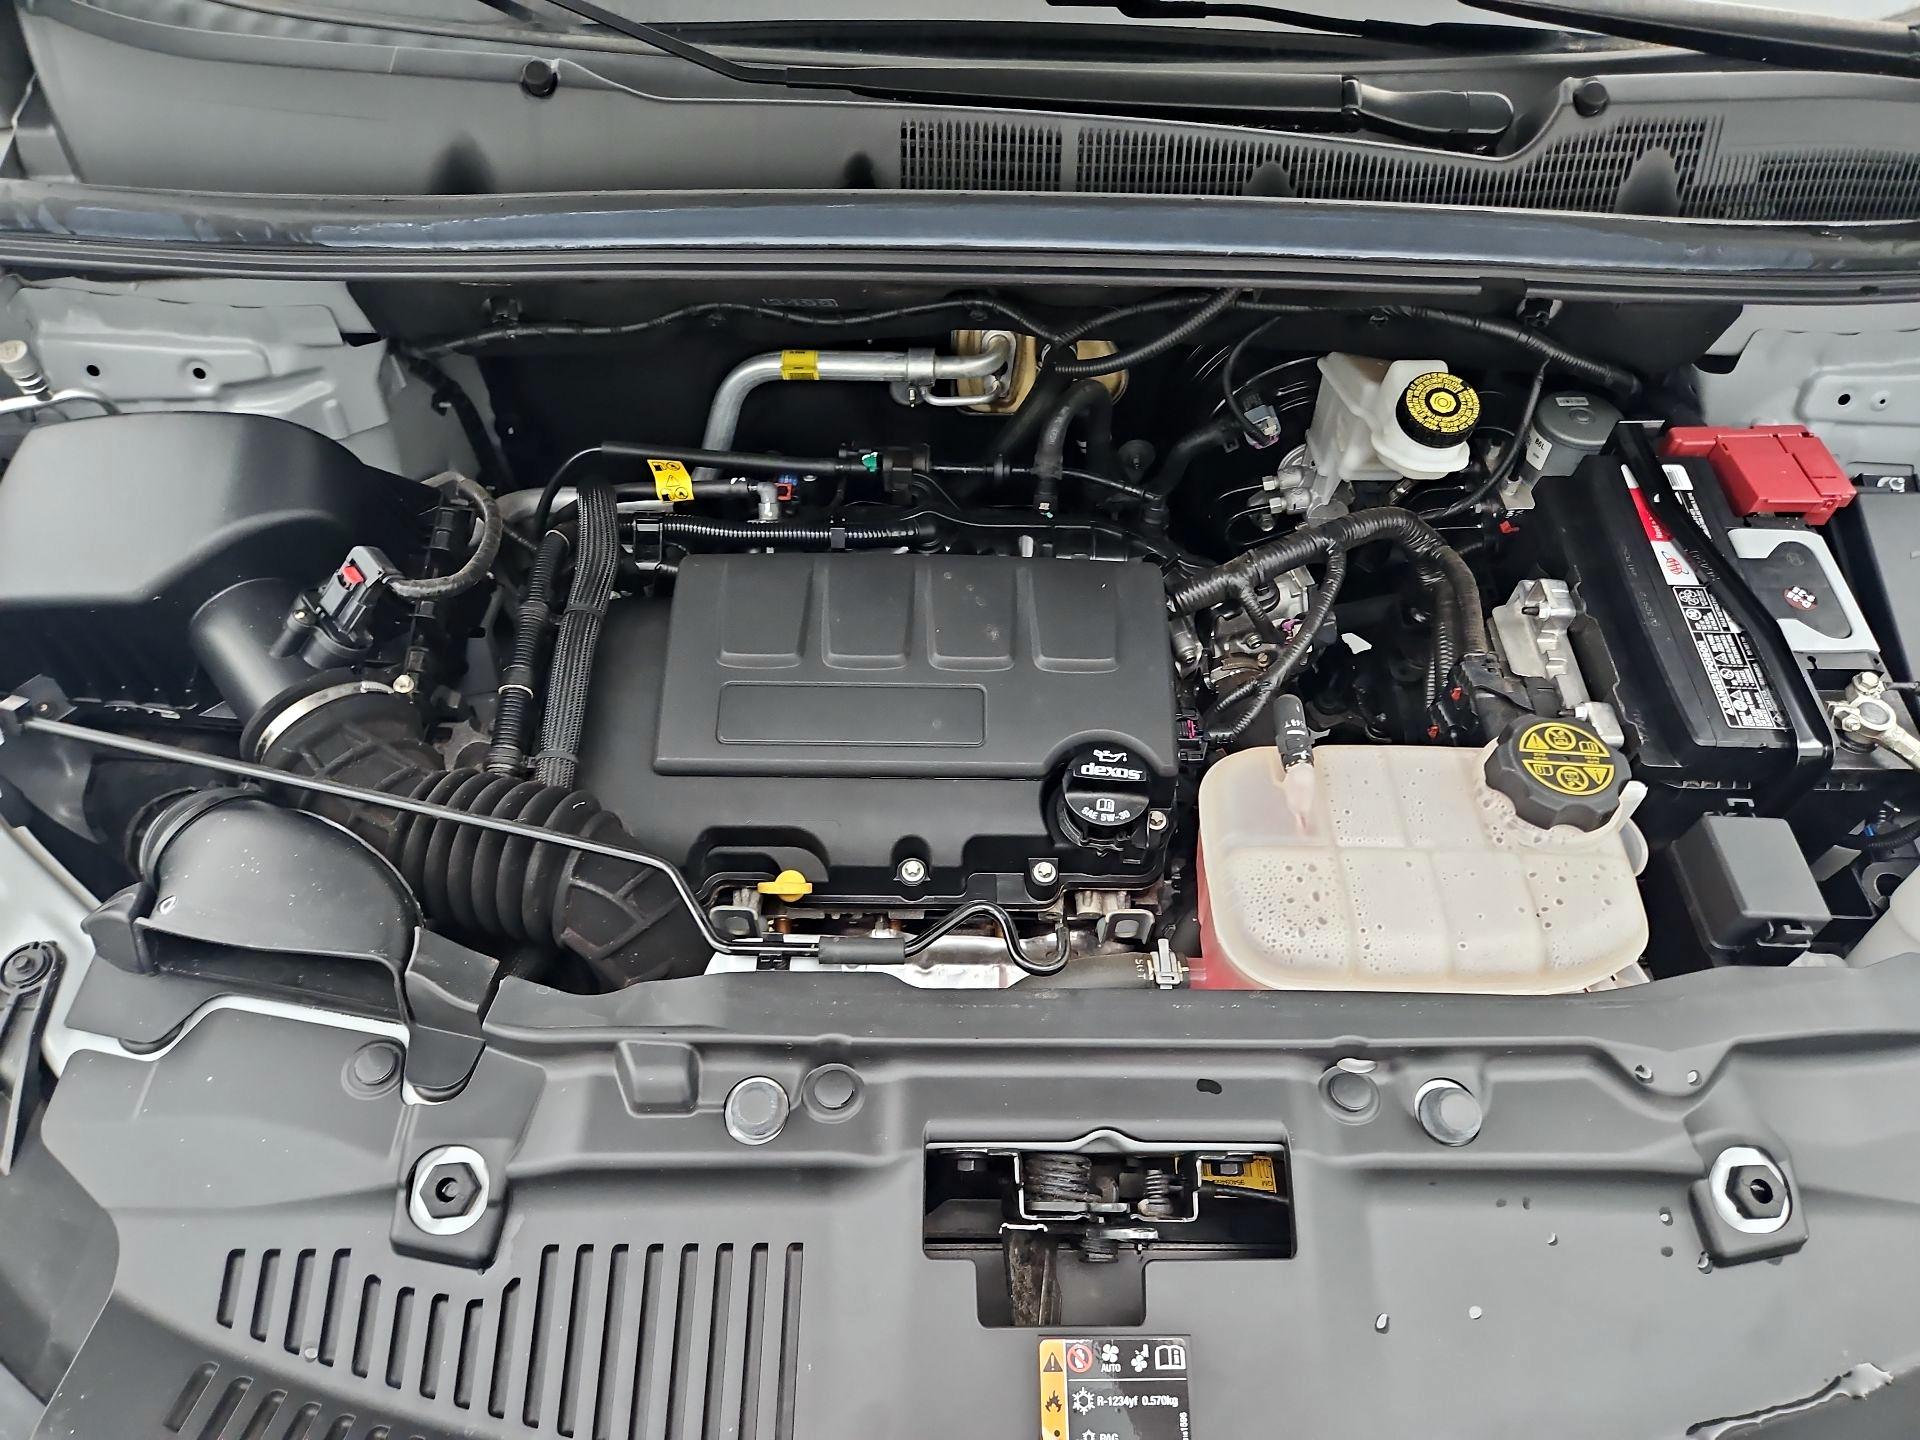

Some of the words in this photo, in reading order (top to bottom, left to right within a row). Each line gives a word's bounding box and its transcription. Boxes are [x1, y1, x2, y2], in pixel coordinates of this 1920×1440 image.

[1697, 640, 1731, 708] DANGER/POISON
[1080, 763, 1143, 780] dexos
[1081, 806, 1099, 820] SAE
[1101, 810, 1131, 822] 5W-30
[1101, 1363, 1122, 1373] AUTO
[1096, 1395, 1138, 1409] R-1234yf
[1141, 1395, 1179, 1408] 0.570kg
